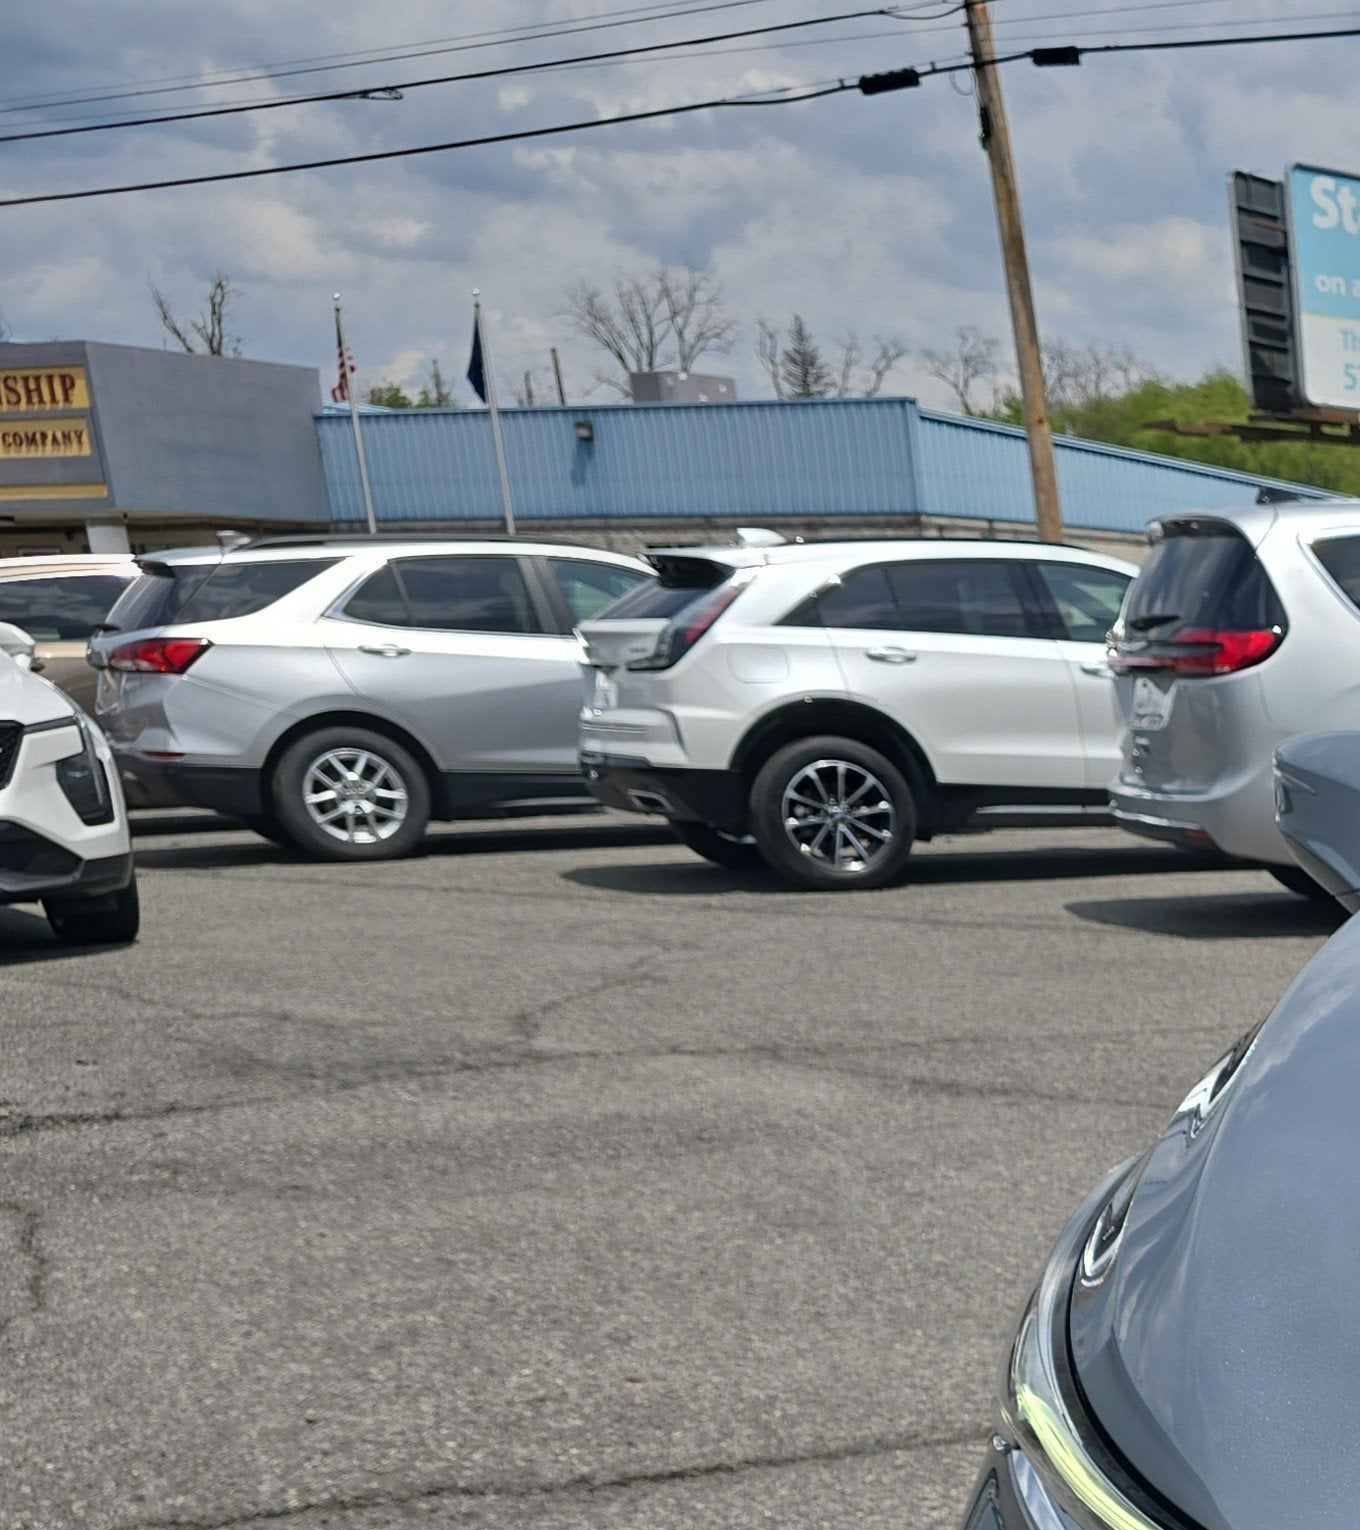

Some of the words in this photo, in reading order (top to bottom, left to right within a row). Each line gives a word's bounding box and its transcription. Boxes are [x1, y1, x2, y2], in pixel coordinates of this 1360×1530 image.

[1315, 273, 1346, 297] on
[0, 374, 76, 406] SHIP
[2, 429, 84, 448] COMPANY
